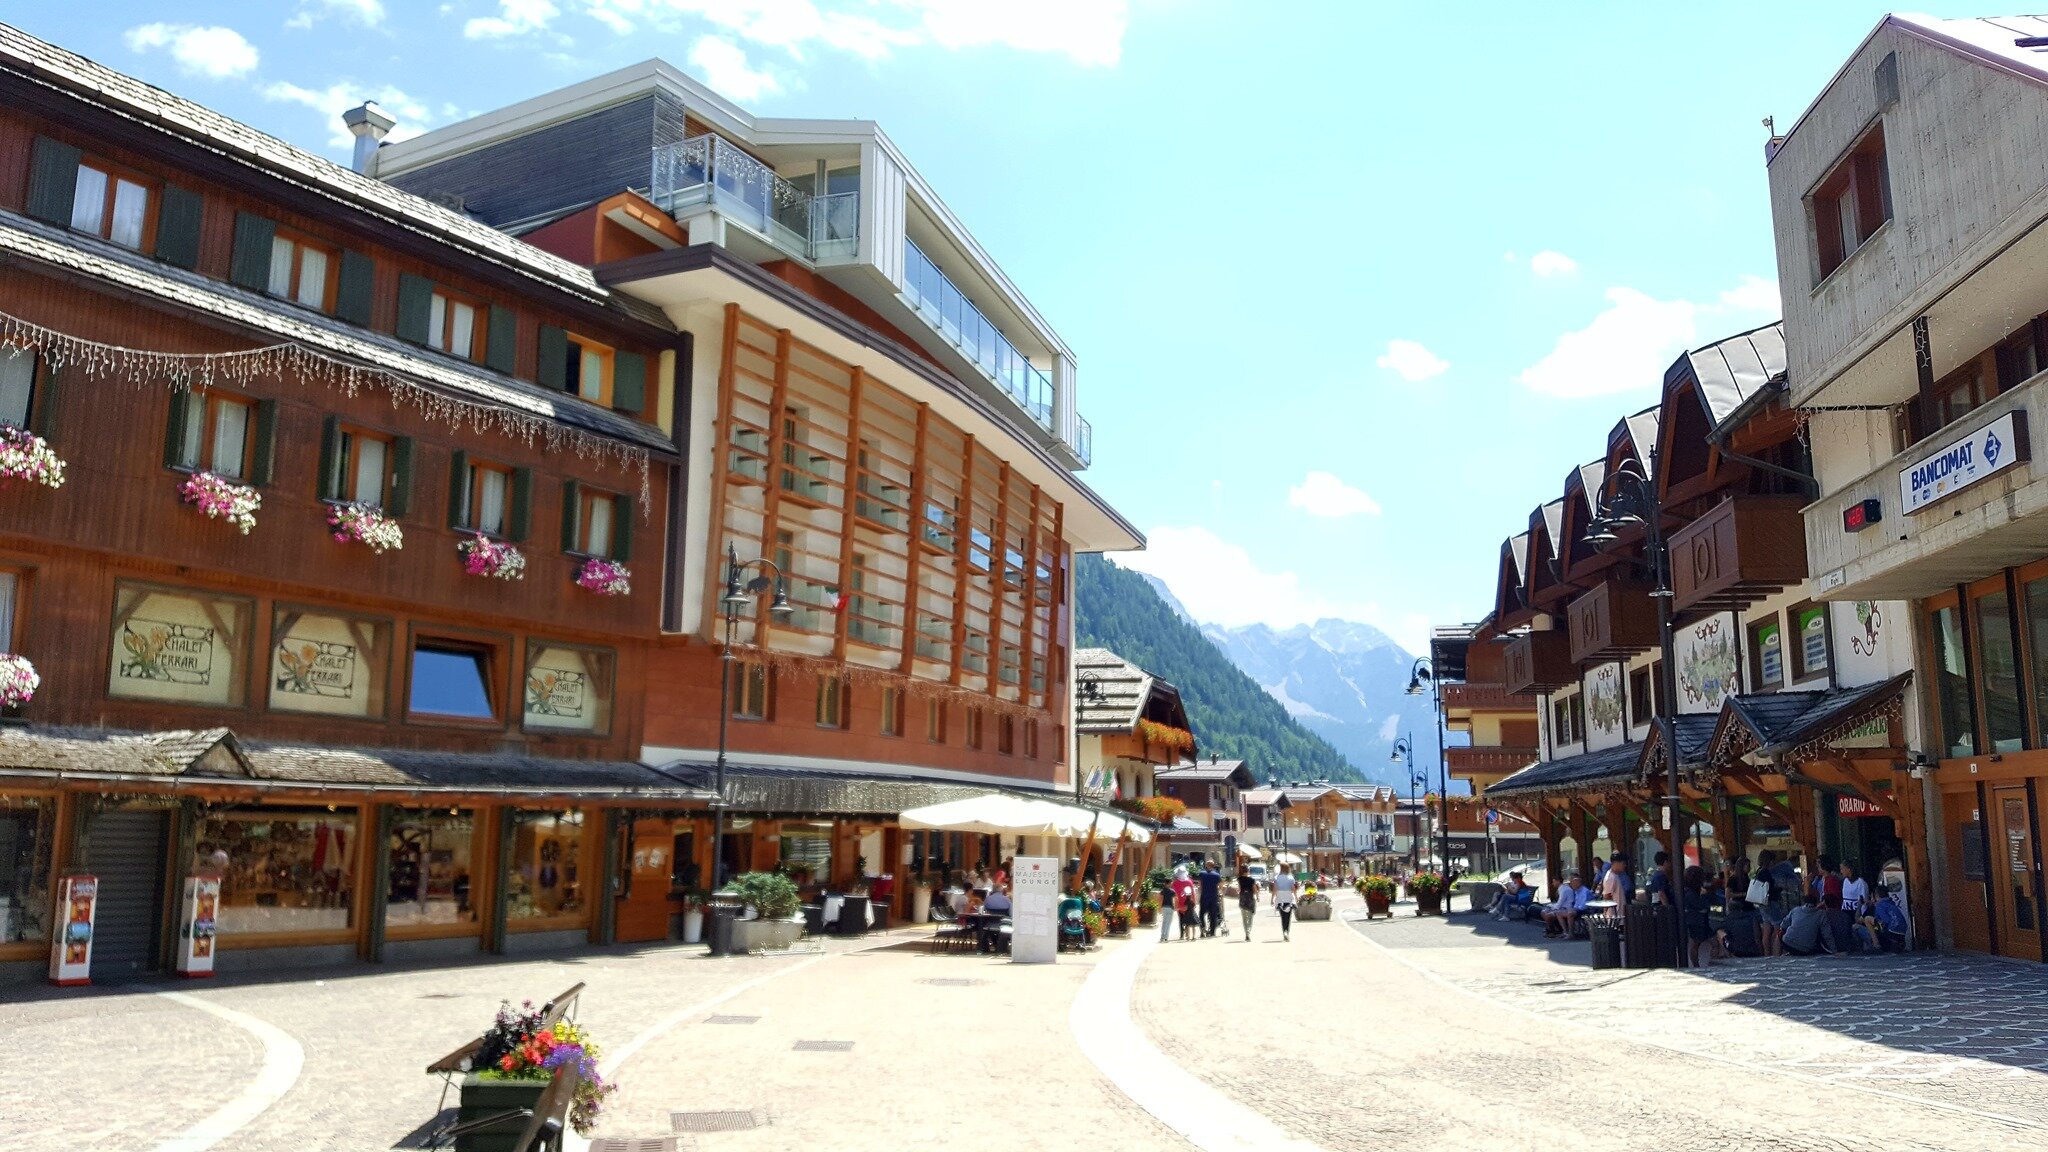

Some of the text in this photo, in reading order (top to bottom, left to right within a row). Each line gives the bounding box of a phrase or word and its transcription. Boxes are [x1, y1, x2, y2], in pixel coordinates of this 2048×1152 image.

[1911, 441, 1973, 491] BANCOMAT
[164, 639, 204, 653] CHALET
[154, 652, 198, 668] FERRARI
[1839, 797, 1866, 813] ORARIO
